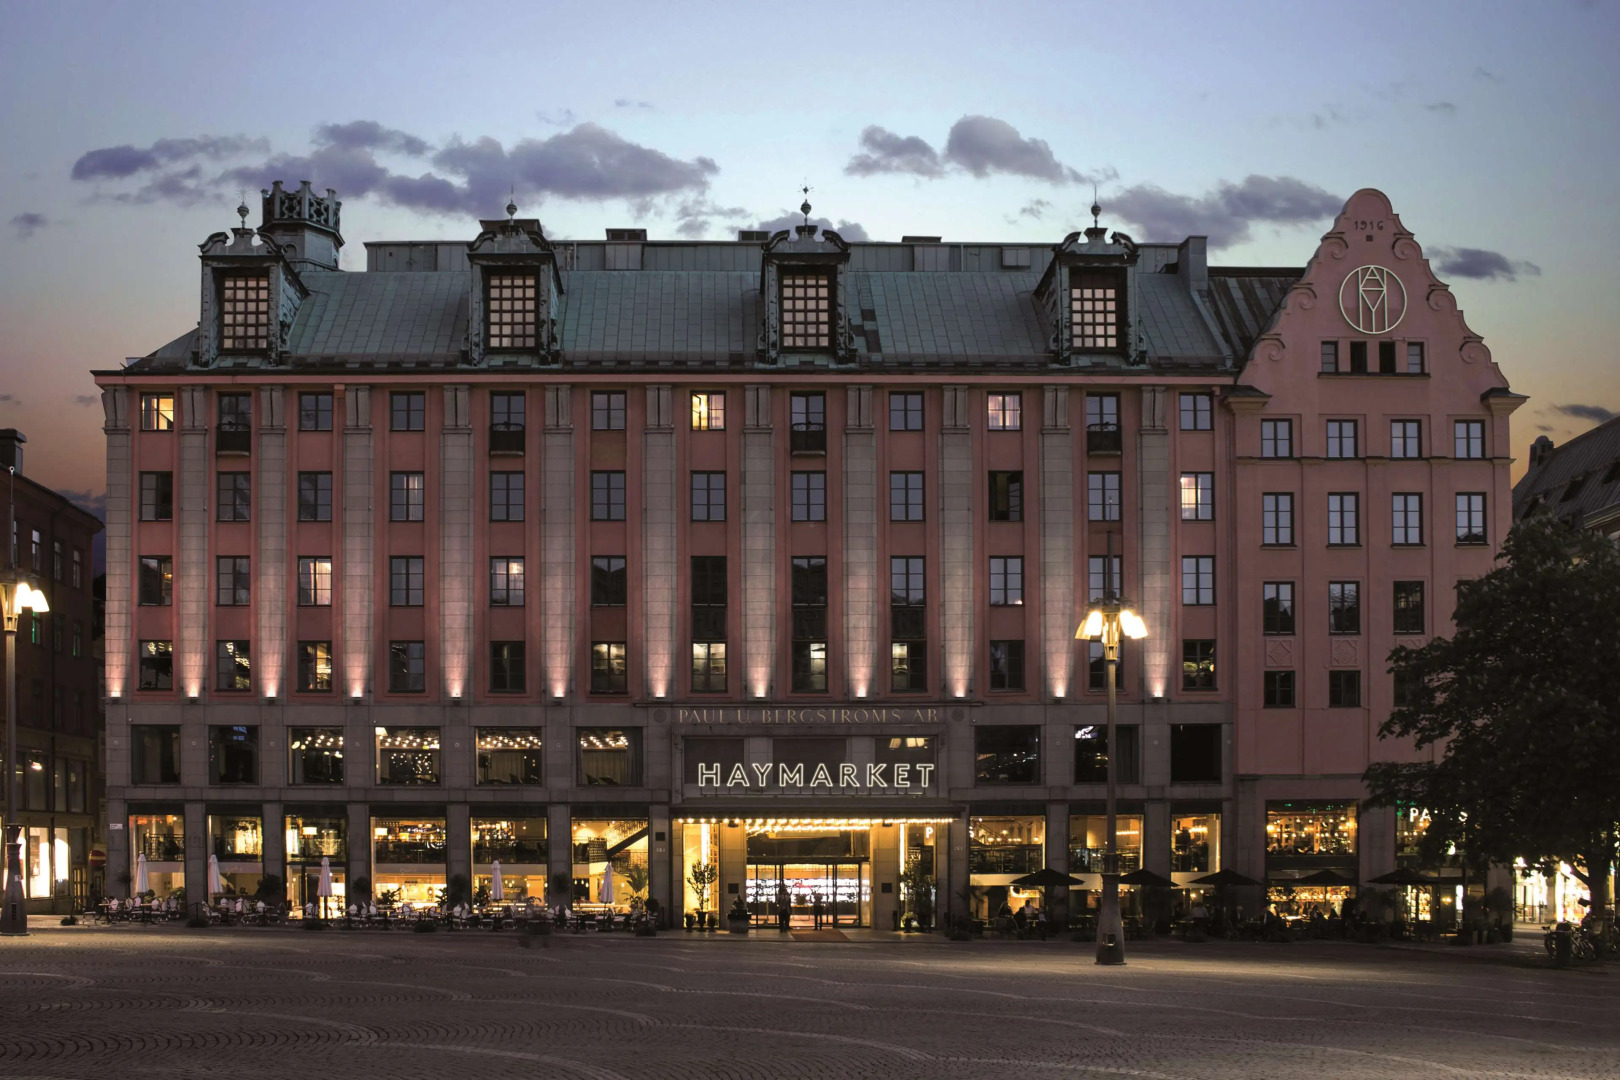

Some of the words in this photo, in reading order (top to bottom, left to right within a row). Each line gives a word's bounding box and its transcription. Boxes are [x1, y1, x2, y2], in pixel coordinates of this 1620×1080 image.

[1354, 220, 1384, 231] 1916
[679, 709, 729, 724] PAUL
[737, 709, 752, 724] U.
[698, 762, 935, 788] HAYMARKET
